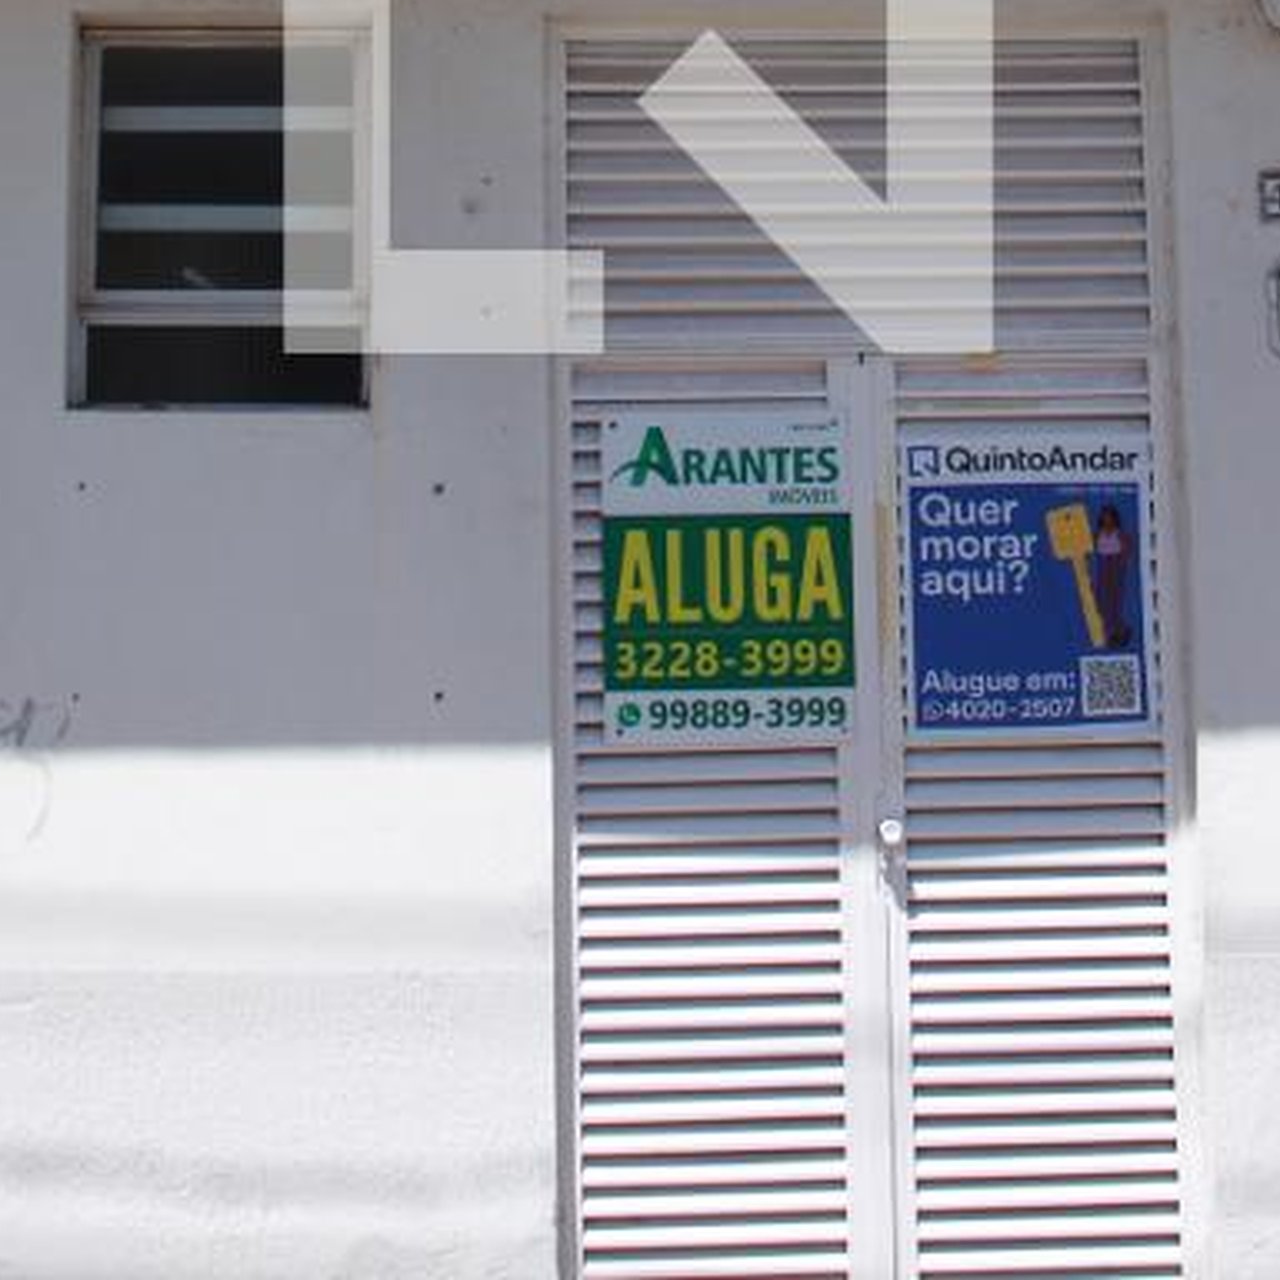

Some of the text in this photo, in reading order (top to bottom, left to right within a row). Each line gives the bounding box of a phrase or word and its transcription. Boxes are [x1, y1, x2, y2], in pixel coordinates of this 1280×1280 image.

[611, 426, 839, 486] ARANTES
[945, 445, 1138, 473] QuintoAndar
[919, 492, 1018, 528] Quer
[921, 533, 1037, 561] morar
[614, 526, 845, 623] ALUGA
[921, 559, 1028, 601] aqui?
[616, 640, 845, 678] 3228-3999
[922, 669, 1076, 697] Alugue em:
[648, 697, 847, 729] 99889-3999
